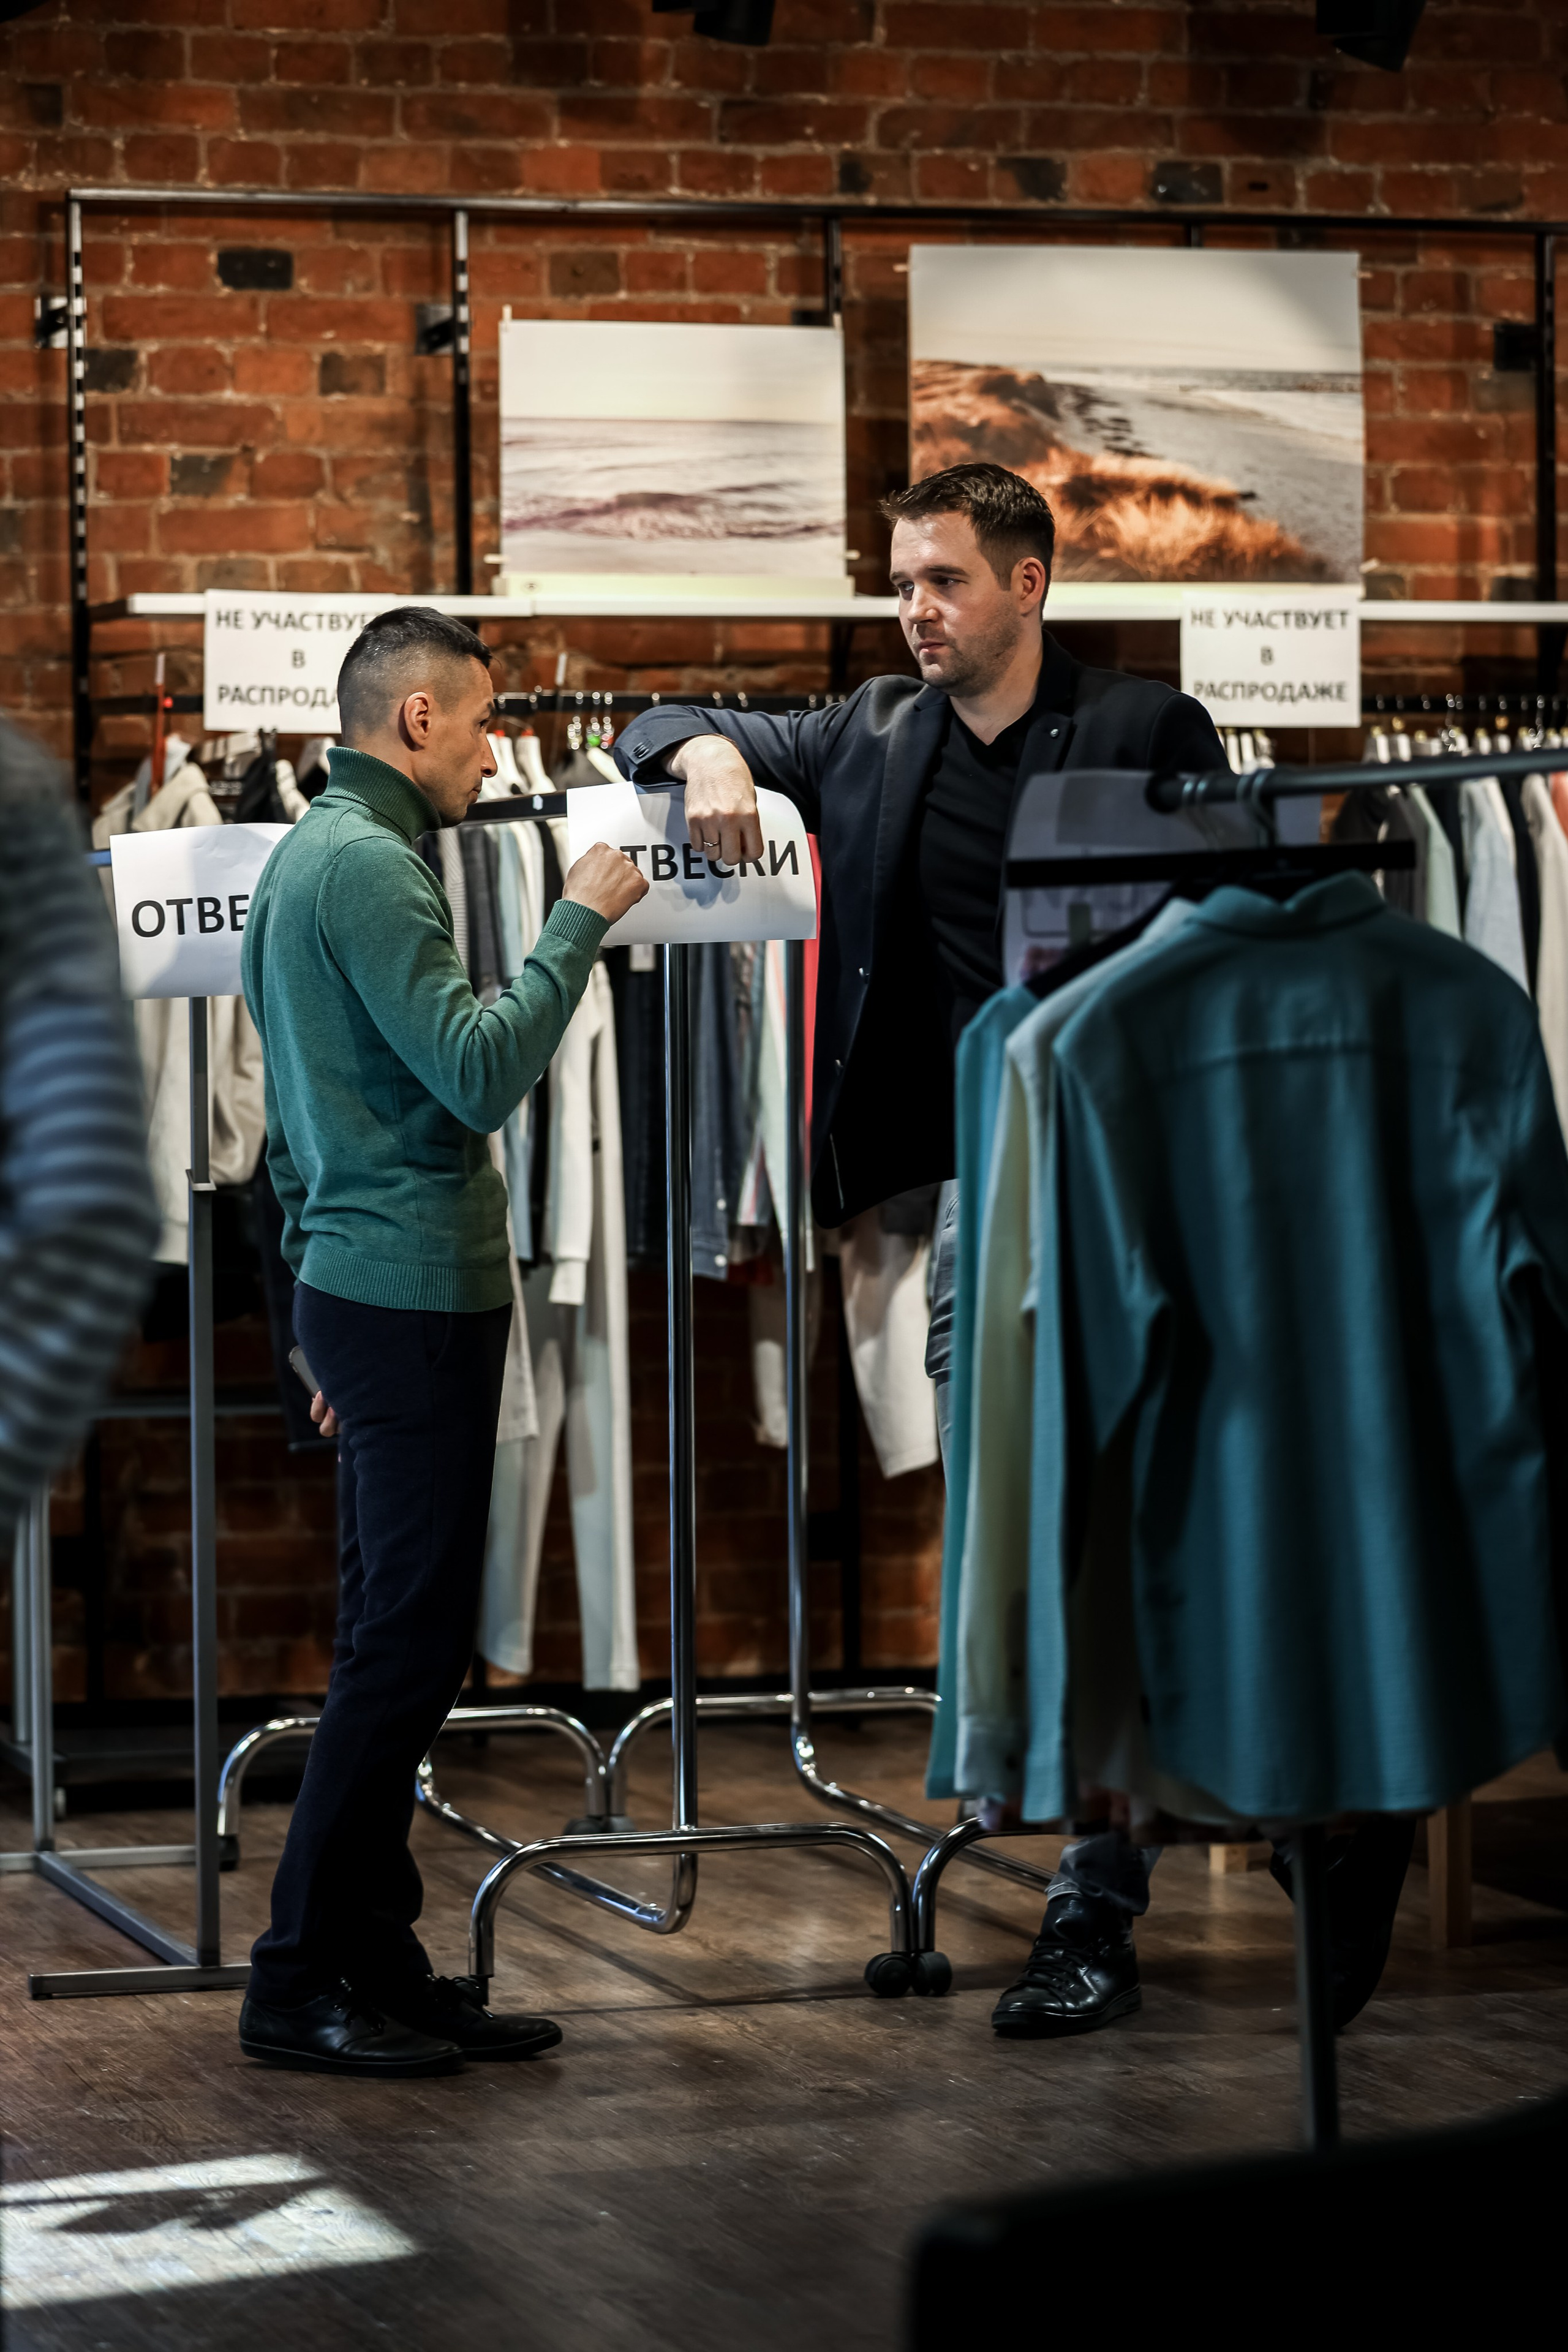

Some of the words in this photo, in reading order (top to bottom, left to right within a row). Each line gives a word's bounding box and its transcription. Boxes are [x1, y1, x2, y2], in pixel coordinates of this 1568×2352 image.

[216, 610, 244, 628] НЕ
[251, 611, 381, 631] УЧАСТВУЕ
[1191, 609, 1214, 627] НЕ
[1224, 610, 1348, 629] УЧАСТВУЕТ
[292, 649, 305, 668] В
[1261, 646, 1274, 665] В
[1194, 681, 1348, 705] РАСПРОДАЖЕ
[132, 894, 249, 937] ОТВЕ
